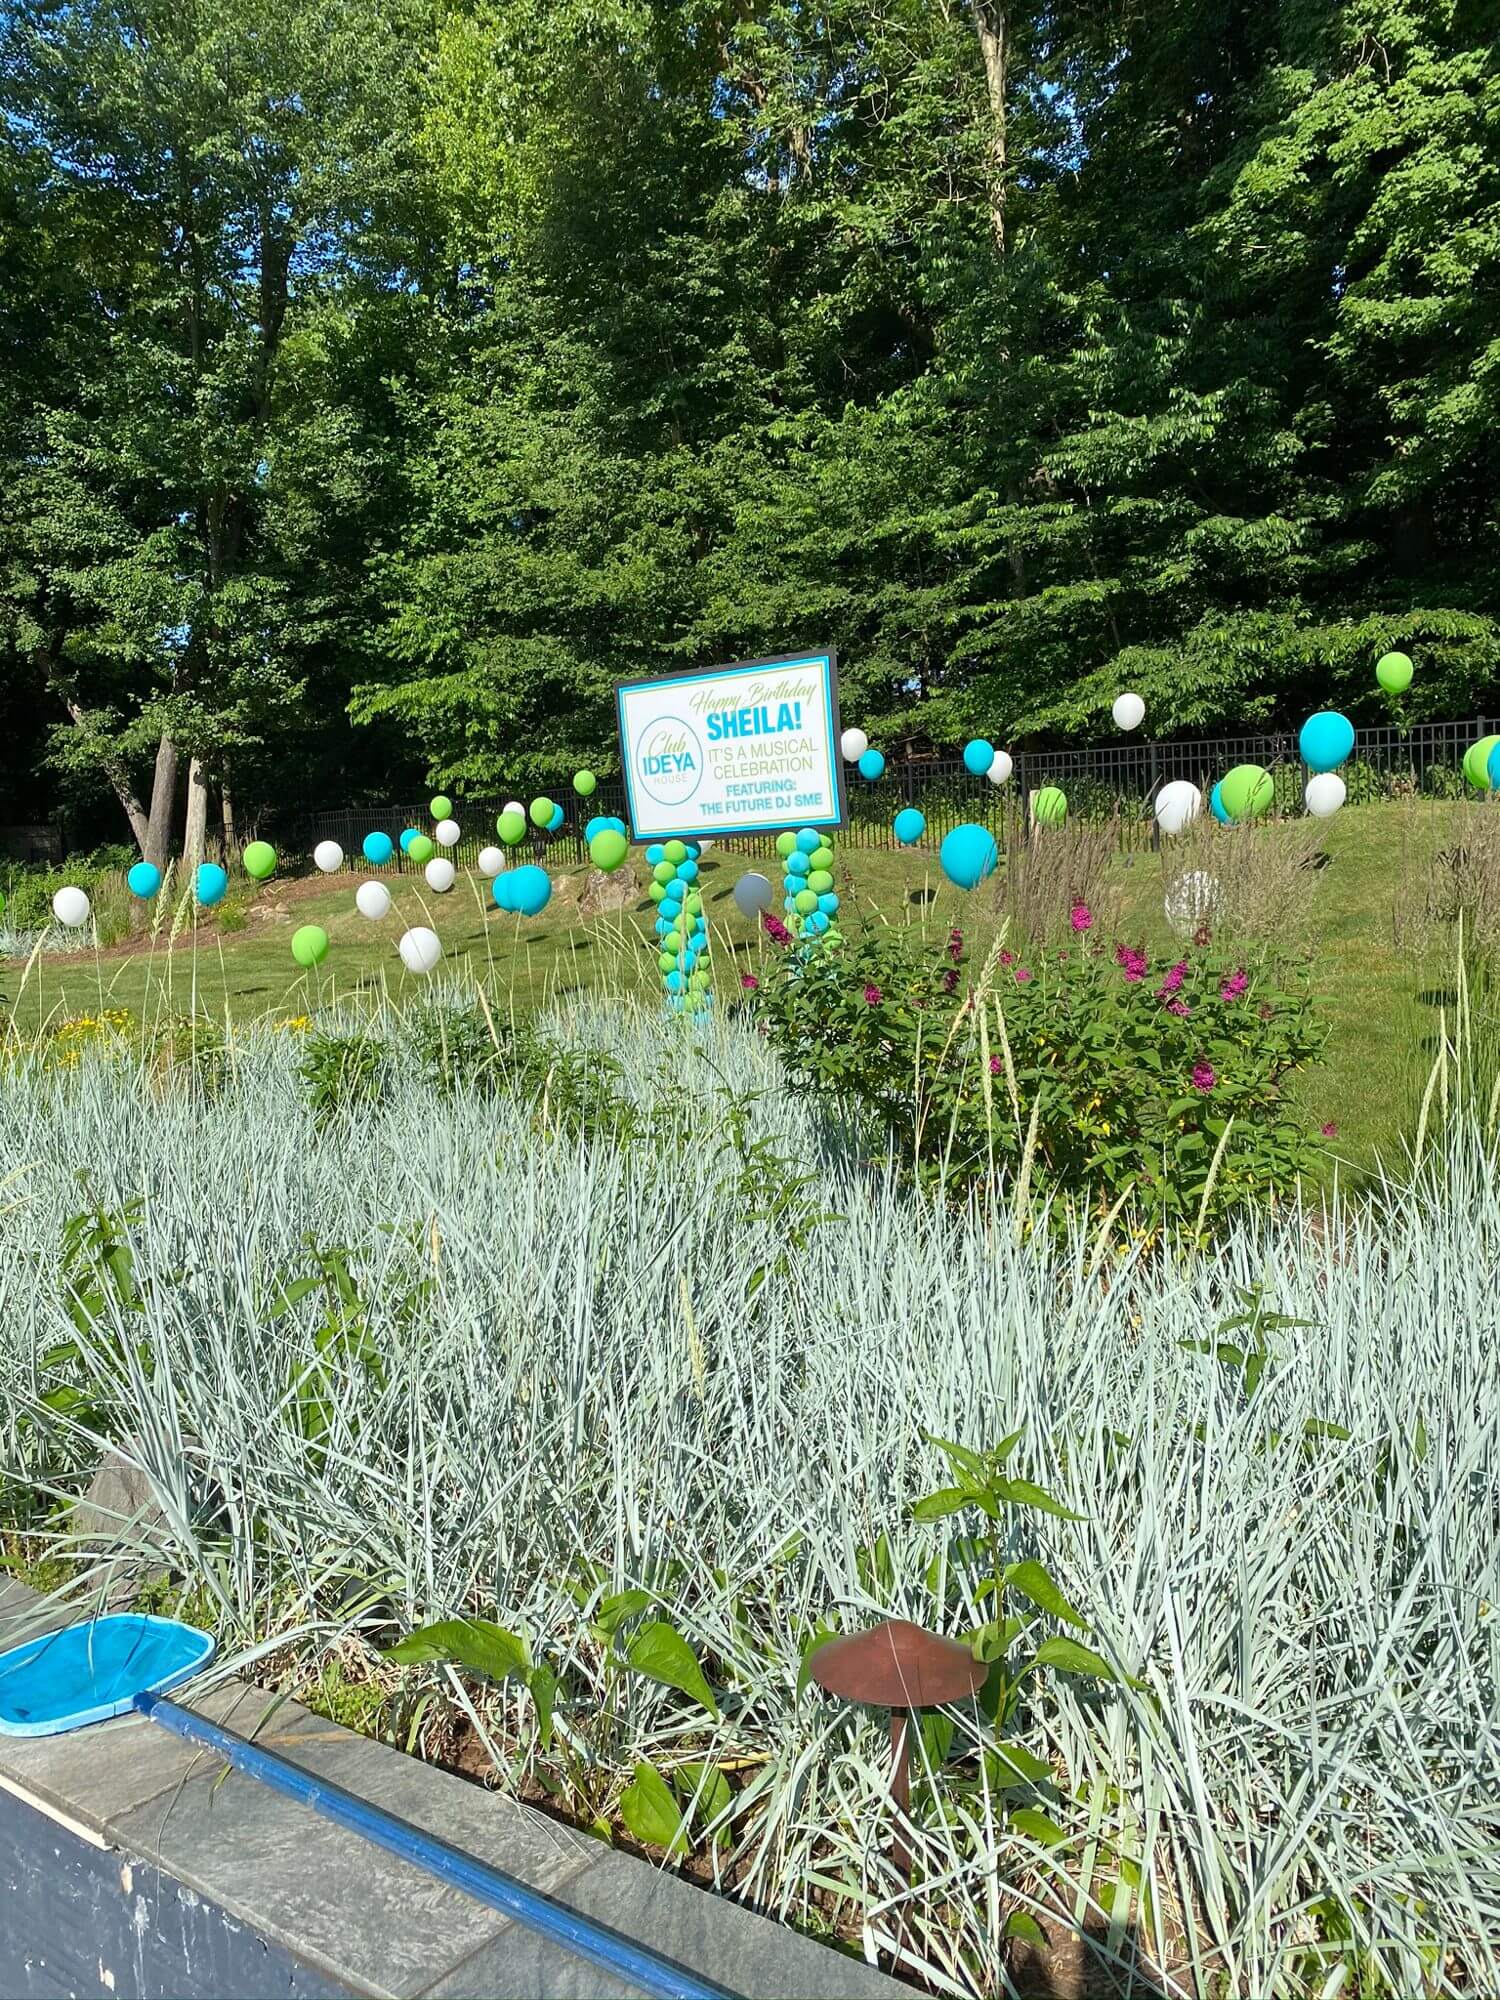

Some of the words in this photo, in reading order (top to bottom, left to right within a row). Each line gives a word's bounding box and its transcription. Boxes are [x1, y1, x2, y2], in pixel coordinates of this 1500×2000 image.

[689, 690, 741, 715] Happy
[741, 678, 817, 708] Birthday
[706, 702, 802, 741] SHEILA!
[648, 731, 687, 760] Club
[708, 748, 733, 763] IT'S
[737, 748, 747, 760] A
[749, 738, 819, 759] MUSICAL
[643, 752, 696, 776] IDEYA
[713, 757, 813, 780] CELEBRATION
[653, 774, 688, 785] HOUSE
[726, 779, 797, 797] FEATURING:
[700, 803, 724, 816] THE
[726, 799, 773, 814] FUTURE
[775, 796, 791, 809] DJ
[794, 793, 823, 806] SME
